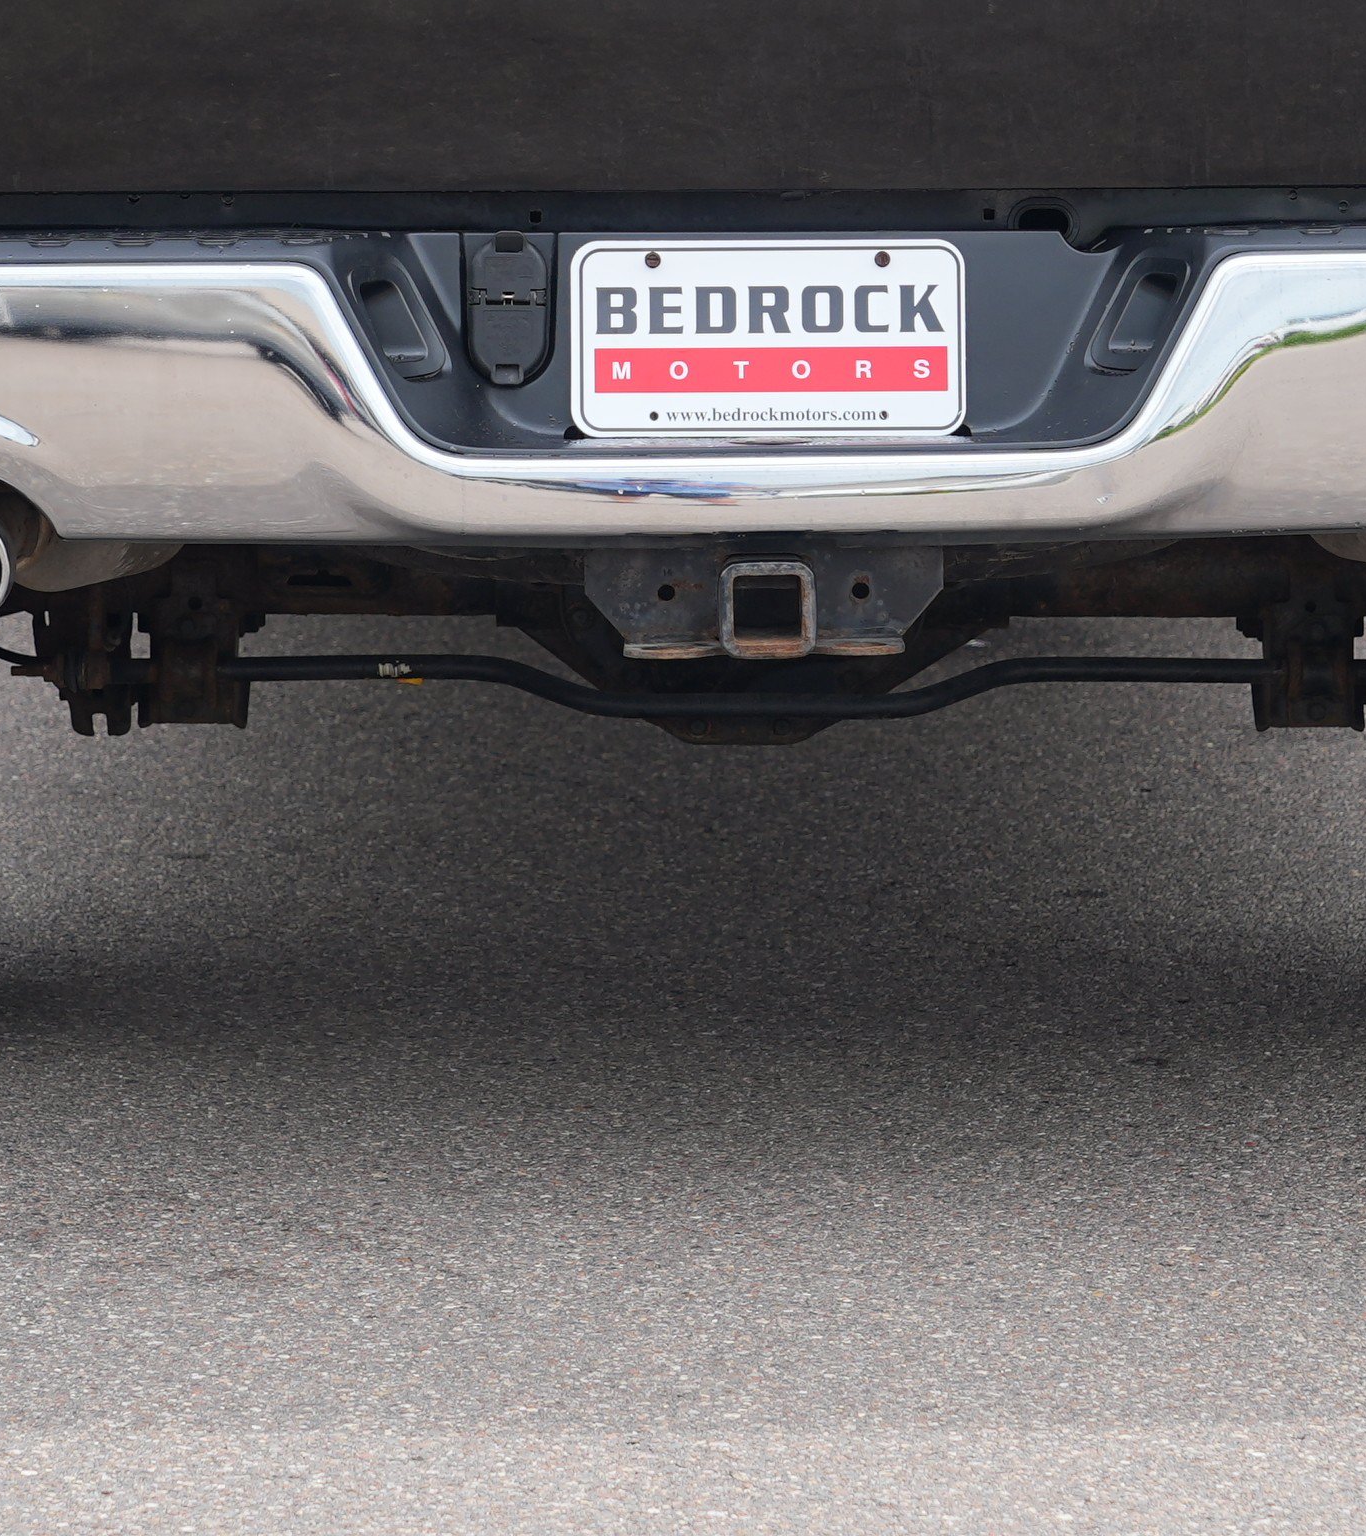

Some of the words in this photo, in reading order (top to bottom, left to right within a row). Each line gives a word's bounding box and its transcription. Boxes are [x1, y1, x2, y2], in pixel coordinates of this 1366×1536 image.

[595, 284, 945, 336] BEDROCK
[611, 359, 932, 381] MOTORS
[666, 407, 877, 424] www.bedrockmotors.com
